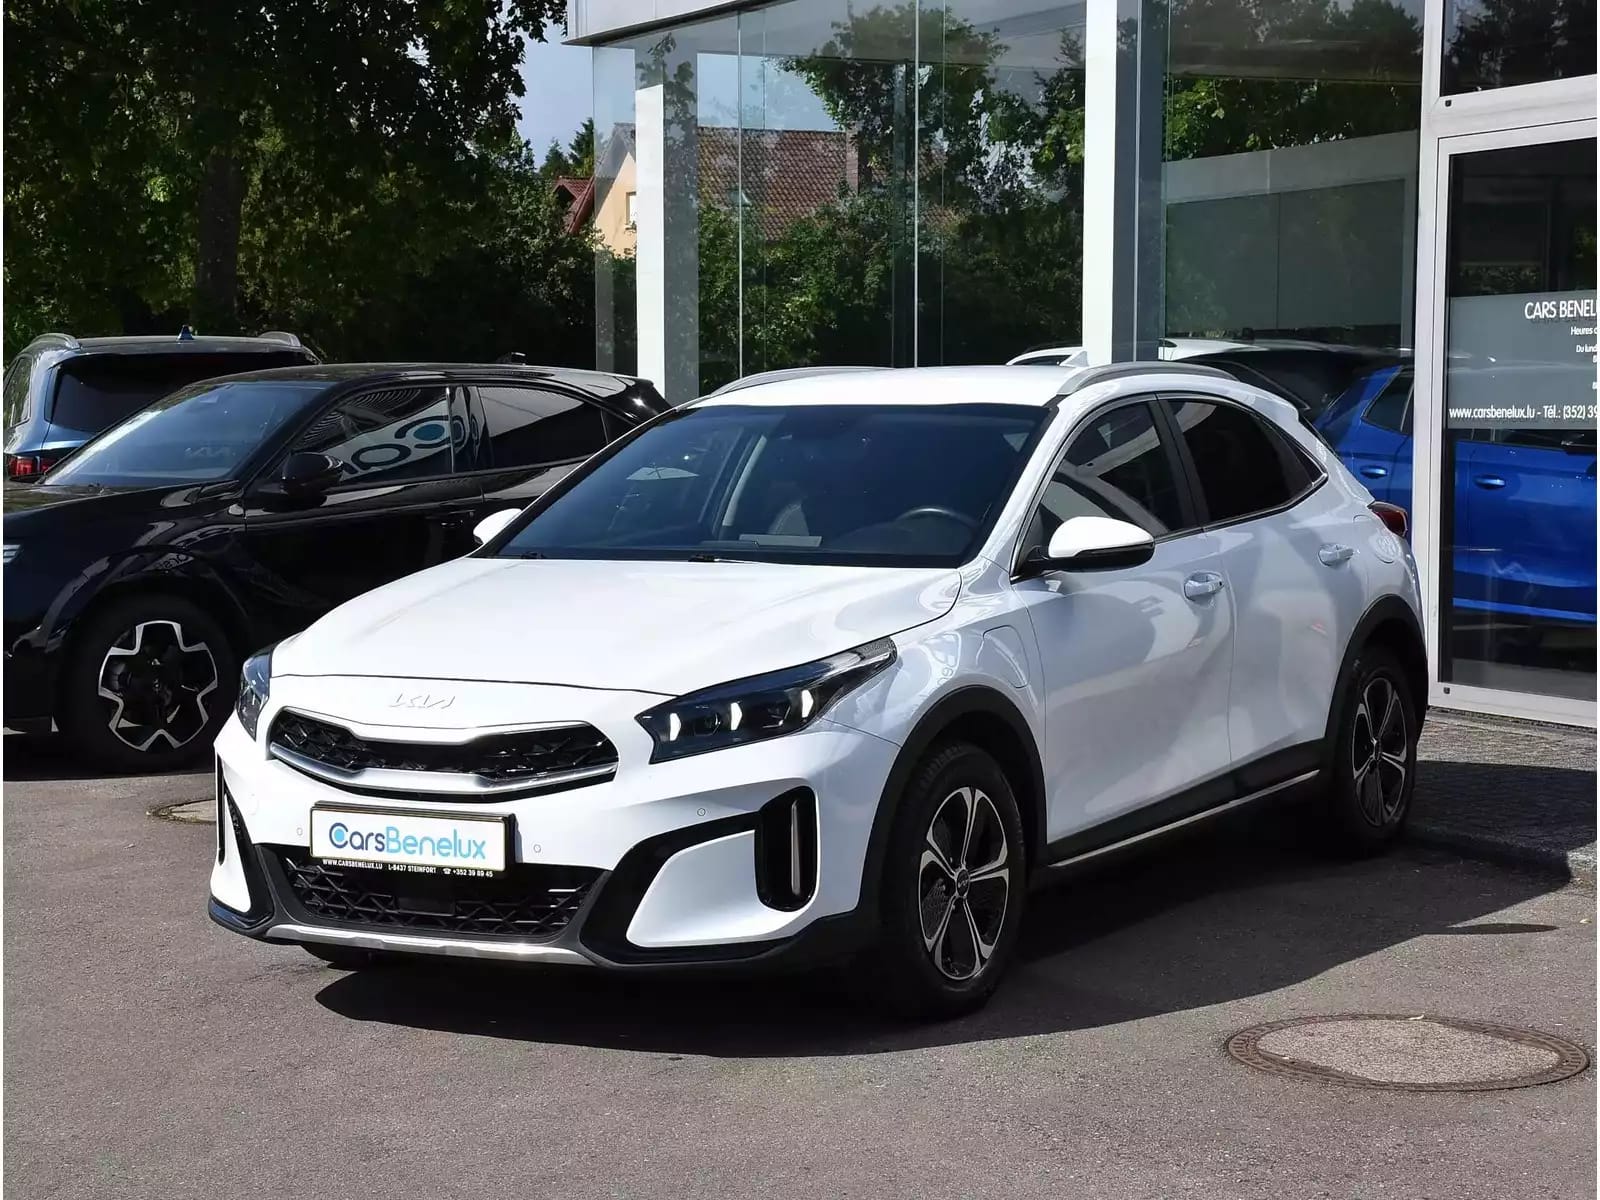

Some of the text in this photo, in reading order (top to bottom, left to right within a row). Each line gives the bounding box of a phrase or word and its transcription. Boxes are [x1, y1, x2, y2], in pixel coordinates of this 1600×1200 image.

[1524, 299, 1597, 319] CARS BENEL
[1570, 326, 1593, 335] Heures
[1449, 404, 1535, 418] www.carsbenelux.lu
[1563, 404, 1586, 420] (352)
[388, 693, 456, 710] KIA
[328, 822, 486, 860] CarsBenelux
[322, 859, 383, 870] WWW.CARSBENELUX.LU
[407, 865, 437, 874] STEINFORT
[452, 868, 467, 876] +352
